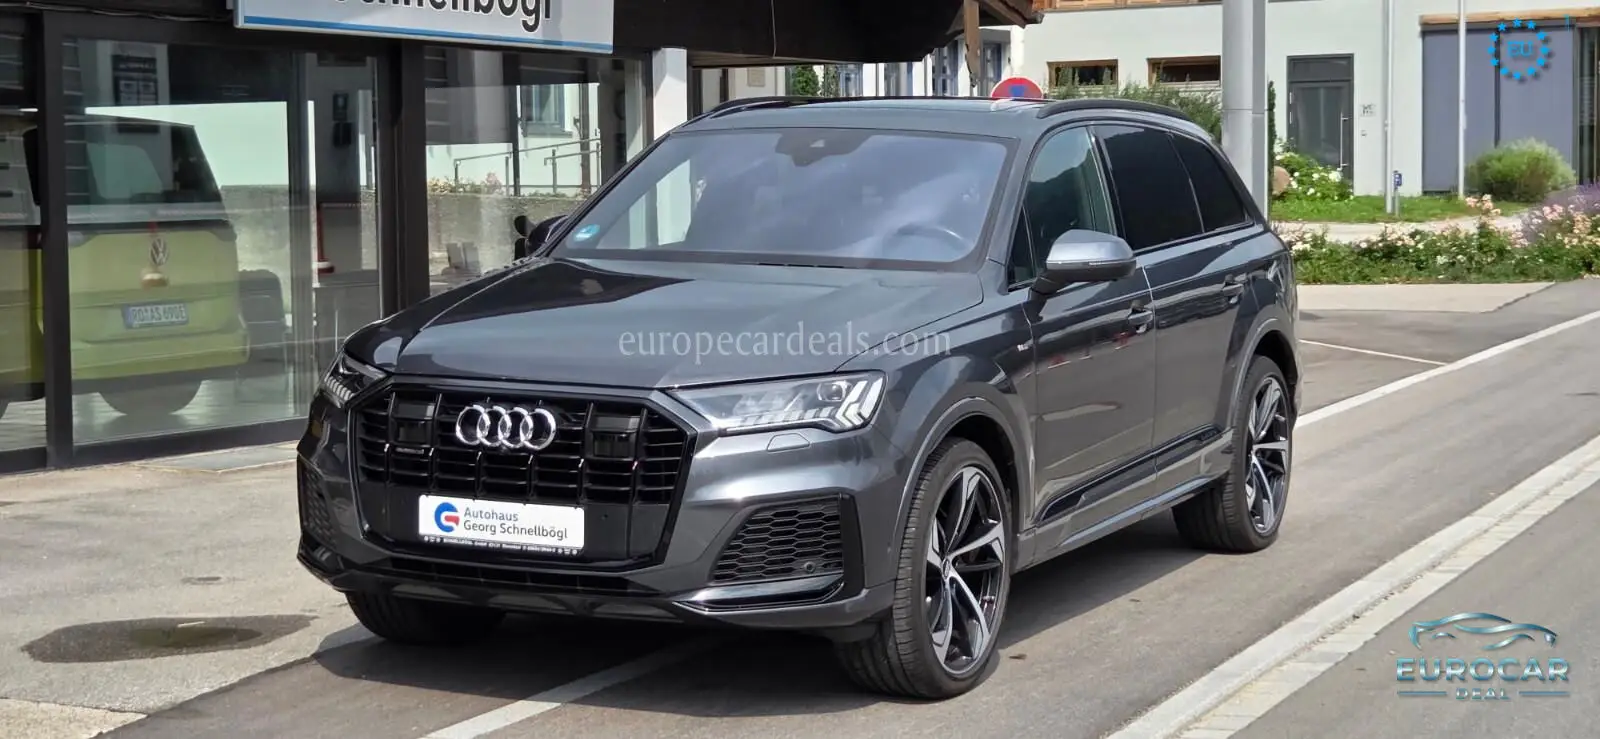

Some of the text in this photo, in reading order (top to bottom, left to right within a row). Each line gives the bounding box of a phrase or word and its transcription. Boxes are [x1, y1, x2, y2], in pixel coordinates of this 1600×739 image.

[464, 507, 519, 522] Autohaus
[463, 520, 568, 541] Georg Schnellbögl
